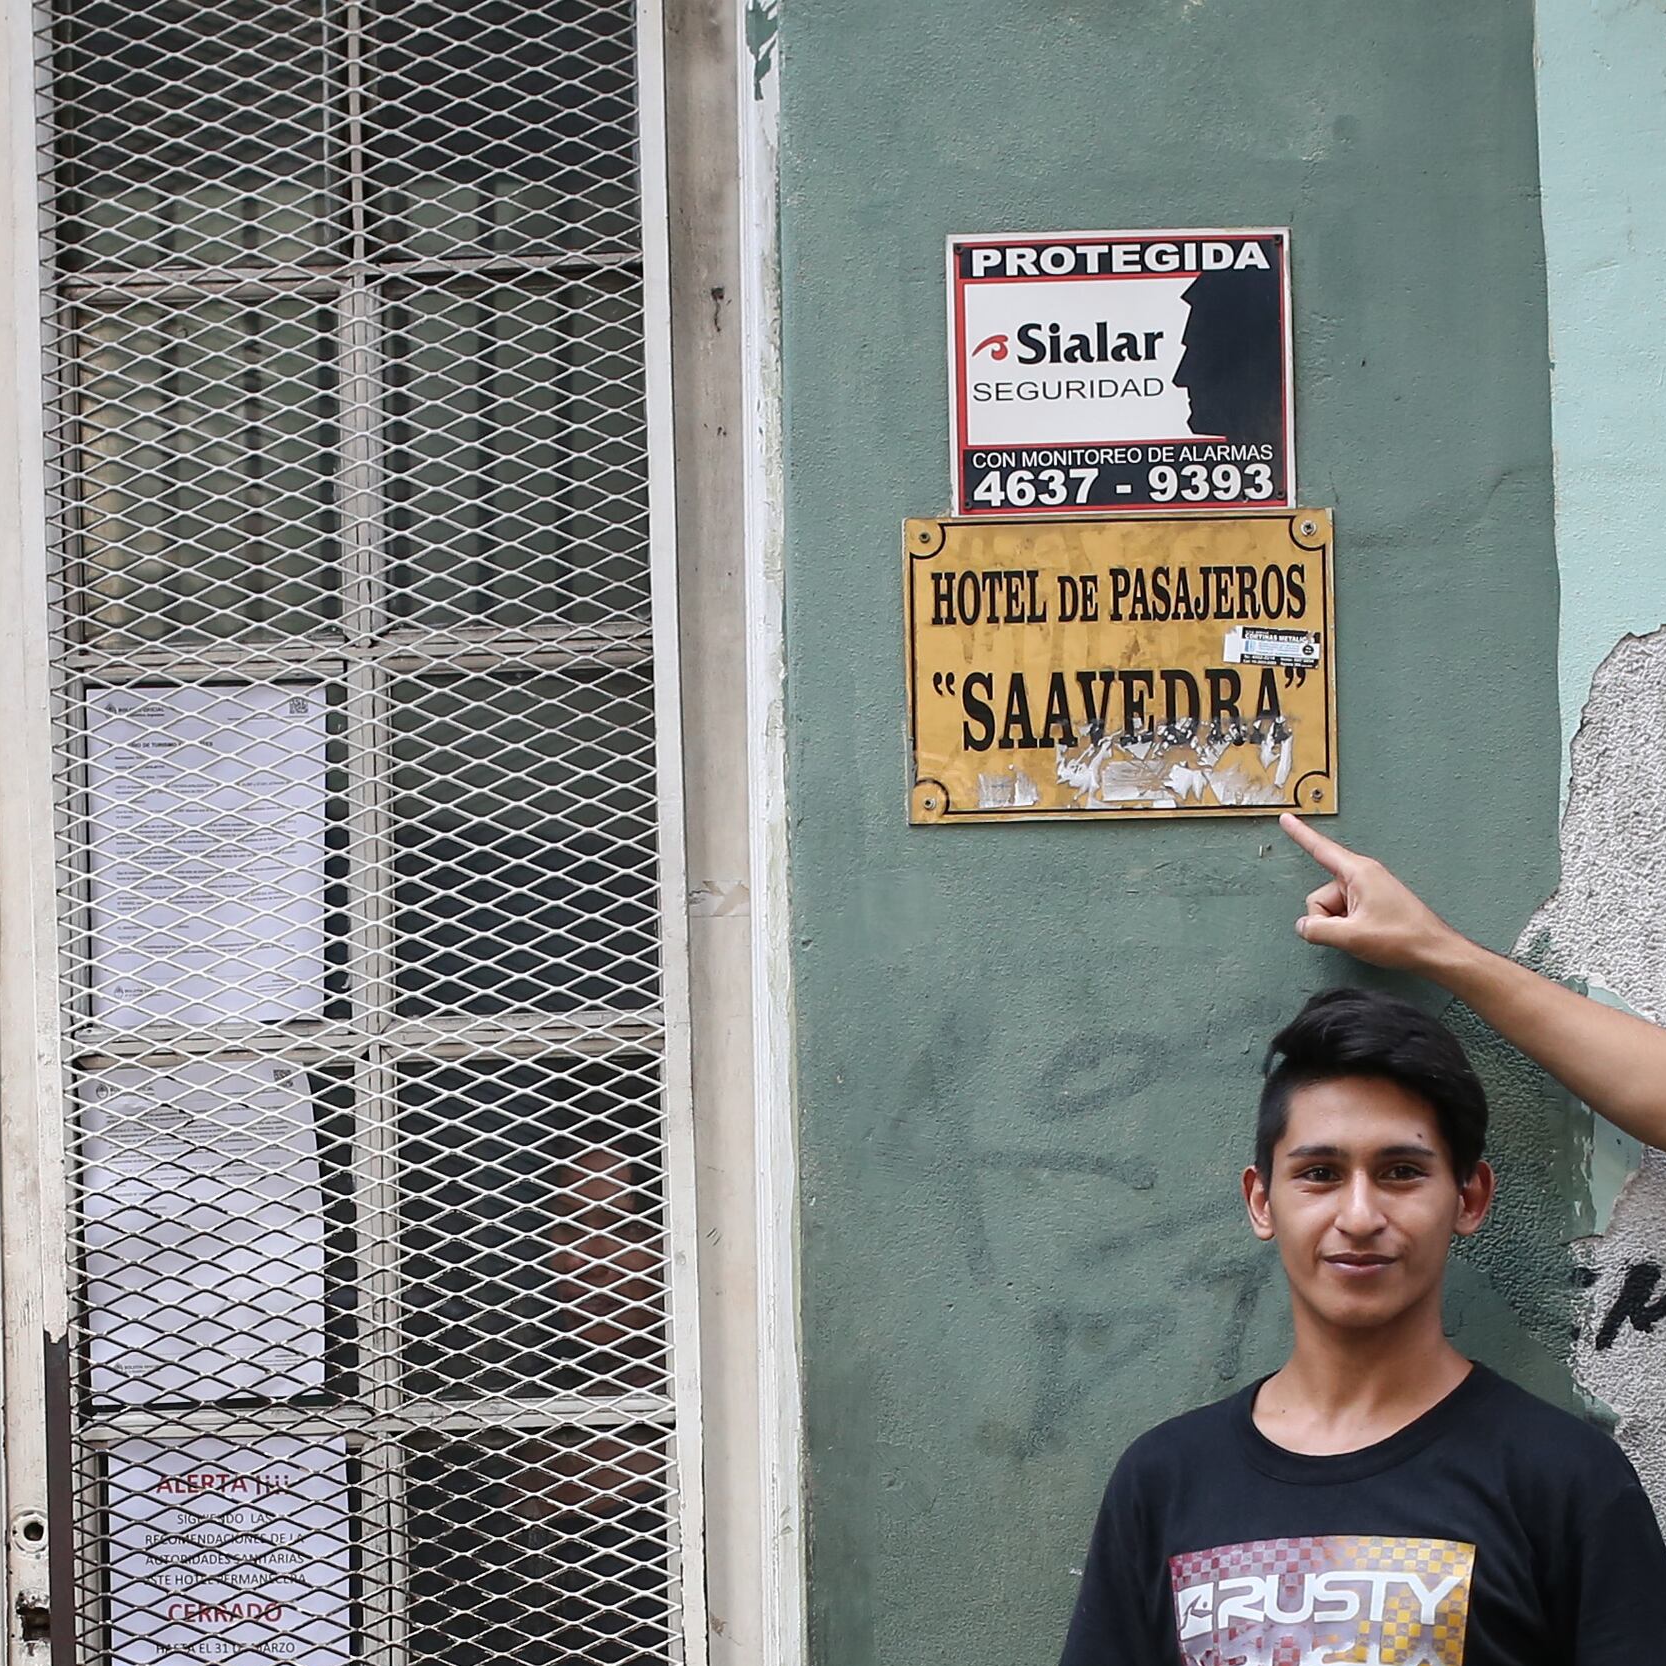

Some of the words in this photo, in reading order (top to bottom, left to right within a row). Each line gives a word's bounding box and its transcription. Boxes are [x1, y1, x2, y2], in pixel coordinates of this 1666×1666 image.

[971, 241, 1271, 277] PROTEGIDA
[1016, 321, 1164, 365] Sialar
[973, 377, 1164, 402] SEGURIDAD
[972, 451, 1016, 469] CON
[1021, 448, 1142, 467] MONITOREO
[1147, 447, 1175, 463] DE
[1179, 444, 1273, 462] ALARMAS
[973, 467, 1099, 507] 4637
[1115, 484, 1132, 494] -
[1148, 463, 1274, 502] 9393
[931, 569, 1047, 626] HOTEL
[1057, 574, 1099, 623] DE
[1109, 563, 1307, 622] PASAJEROS
[157, 1474, 248, 1494] ALERTA
[250, 1513, 273, 1524] LAS
[270, 1533, 286, 1544] DE
[145, 1574, 172, 1585] STE
[168, 1603, 282, 1622] CERRADO
[1219, 1570, 1463, 1630] RUSTY
[199, 1643, 212, 1654] EL
[215, 1643, 228, 1654] 31
